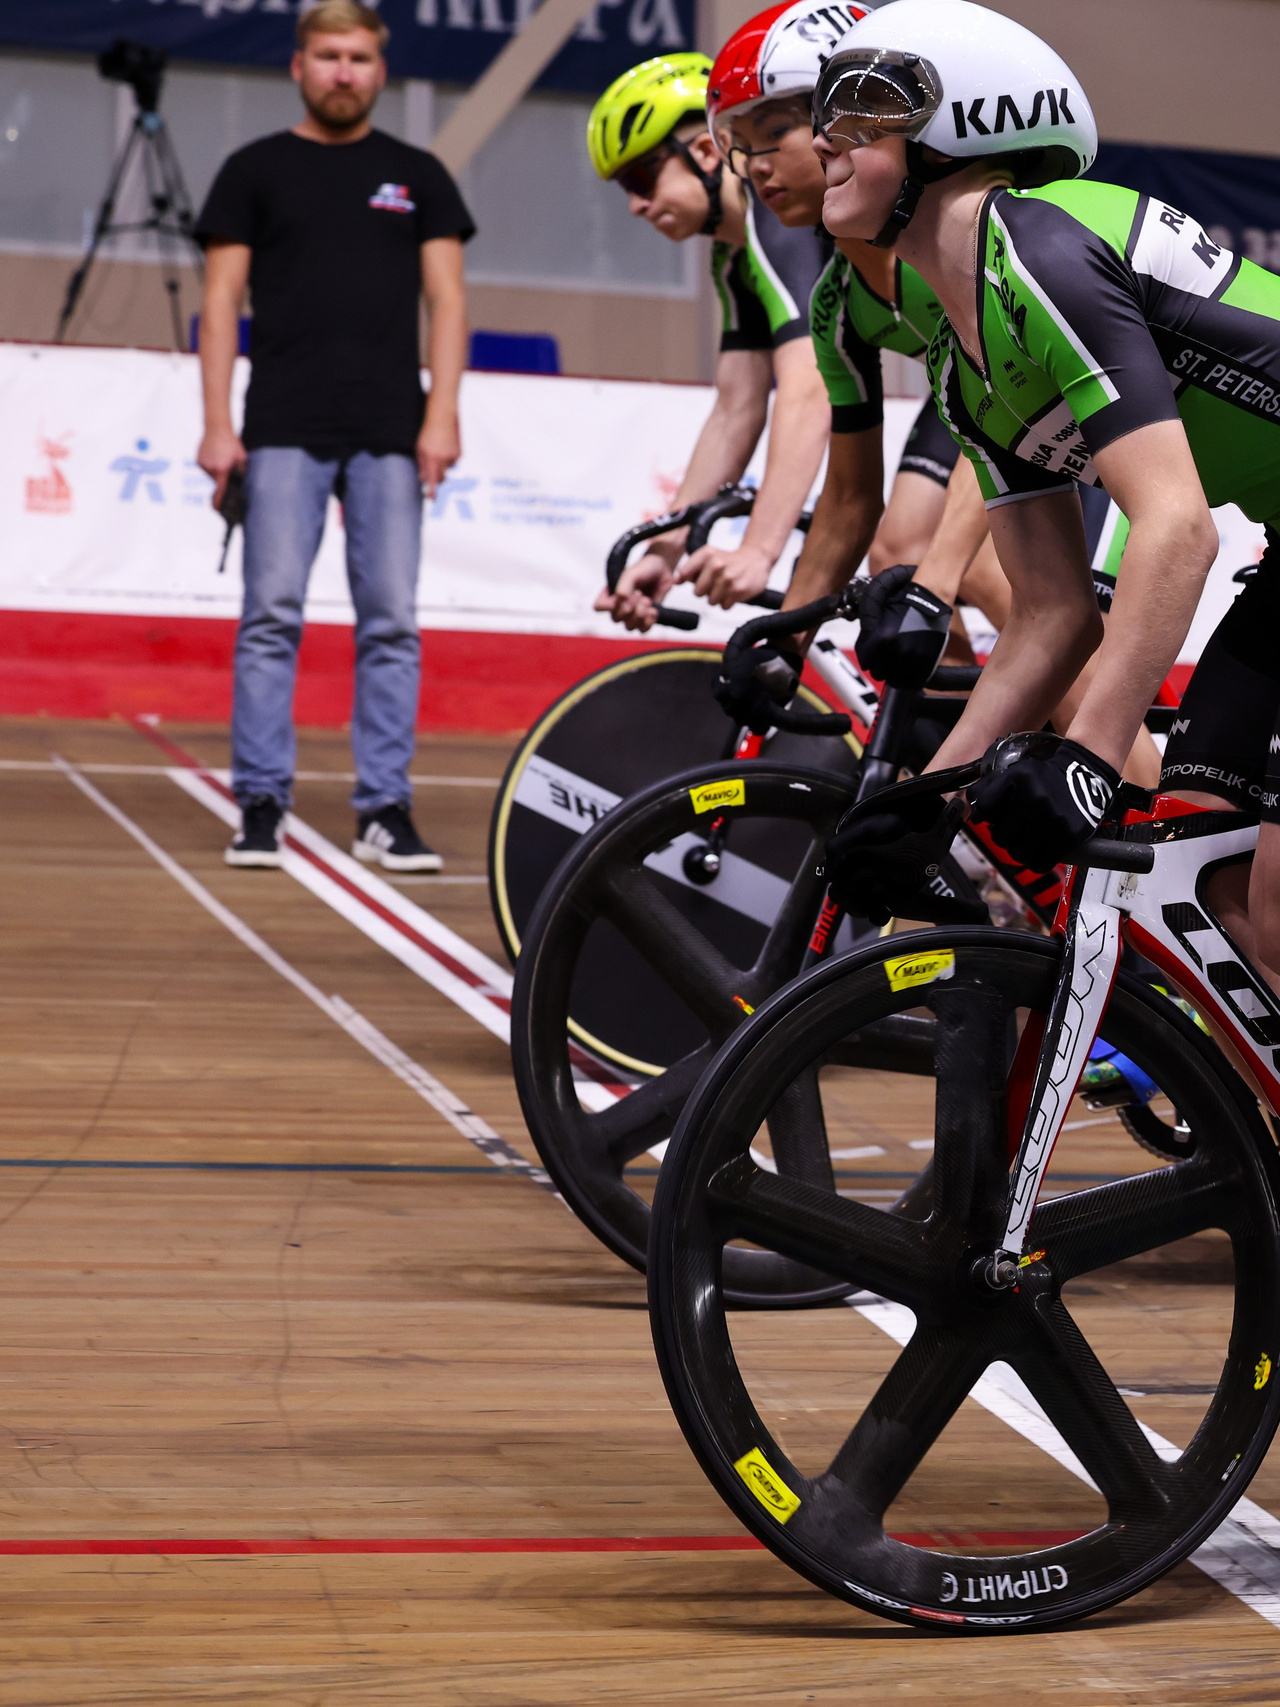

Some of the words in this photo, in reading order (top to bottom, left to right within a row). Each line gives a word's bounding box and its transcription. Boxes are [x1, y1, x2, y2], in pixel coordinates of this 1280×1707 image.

[952, 87, 1076, 139] KASK
[1172, 349, 1208, 378] ST.
[703, 789, 733, 802] MAVIC
[808, 898, 839, 955] BMC
[962, 1565, 1068, 1603] СПРИНТ
